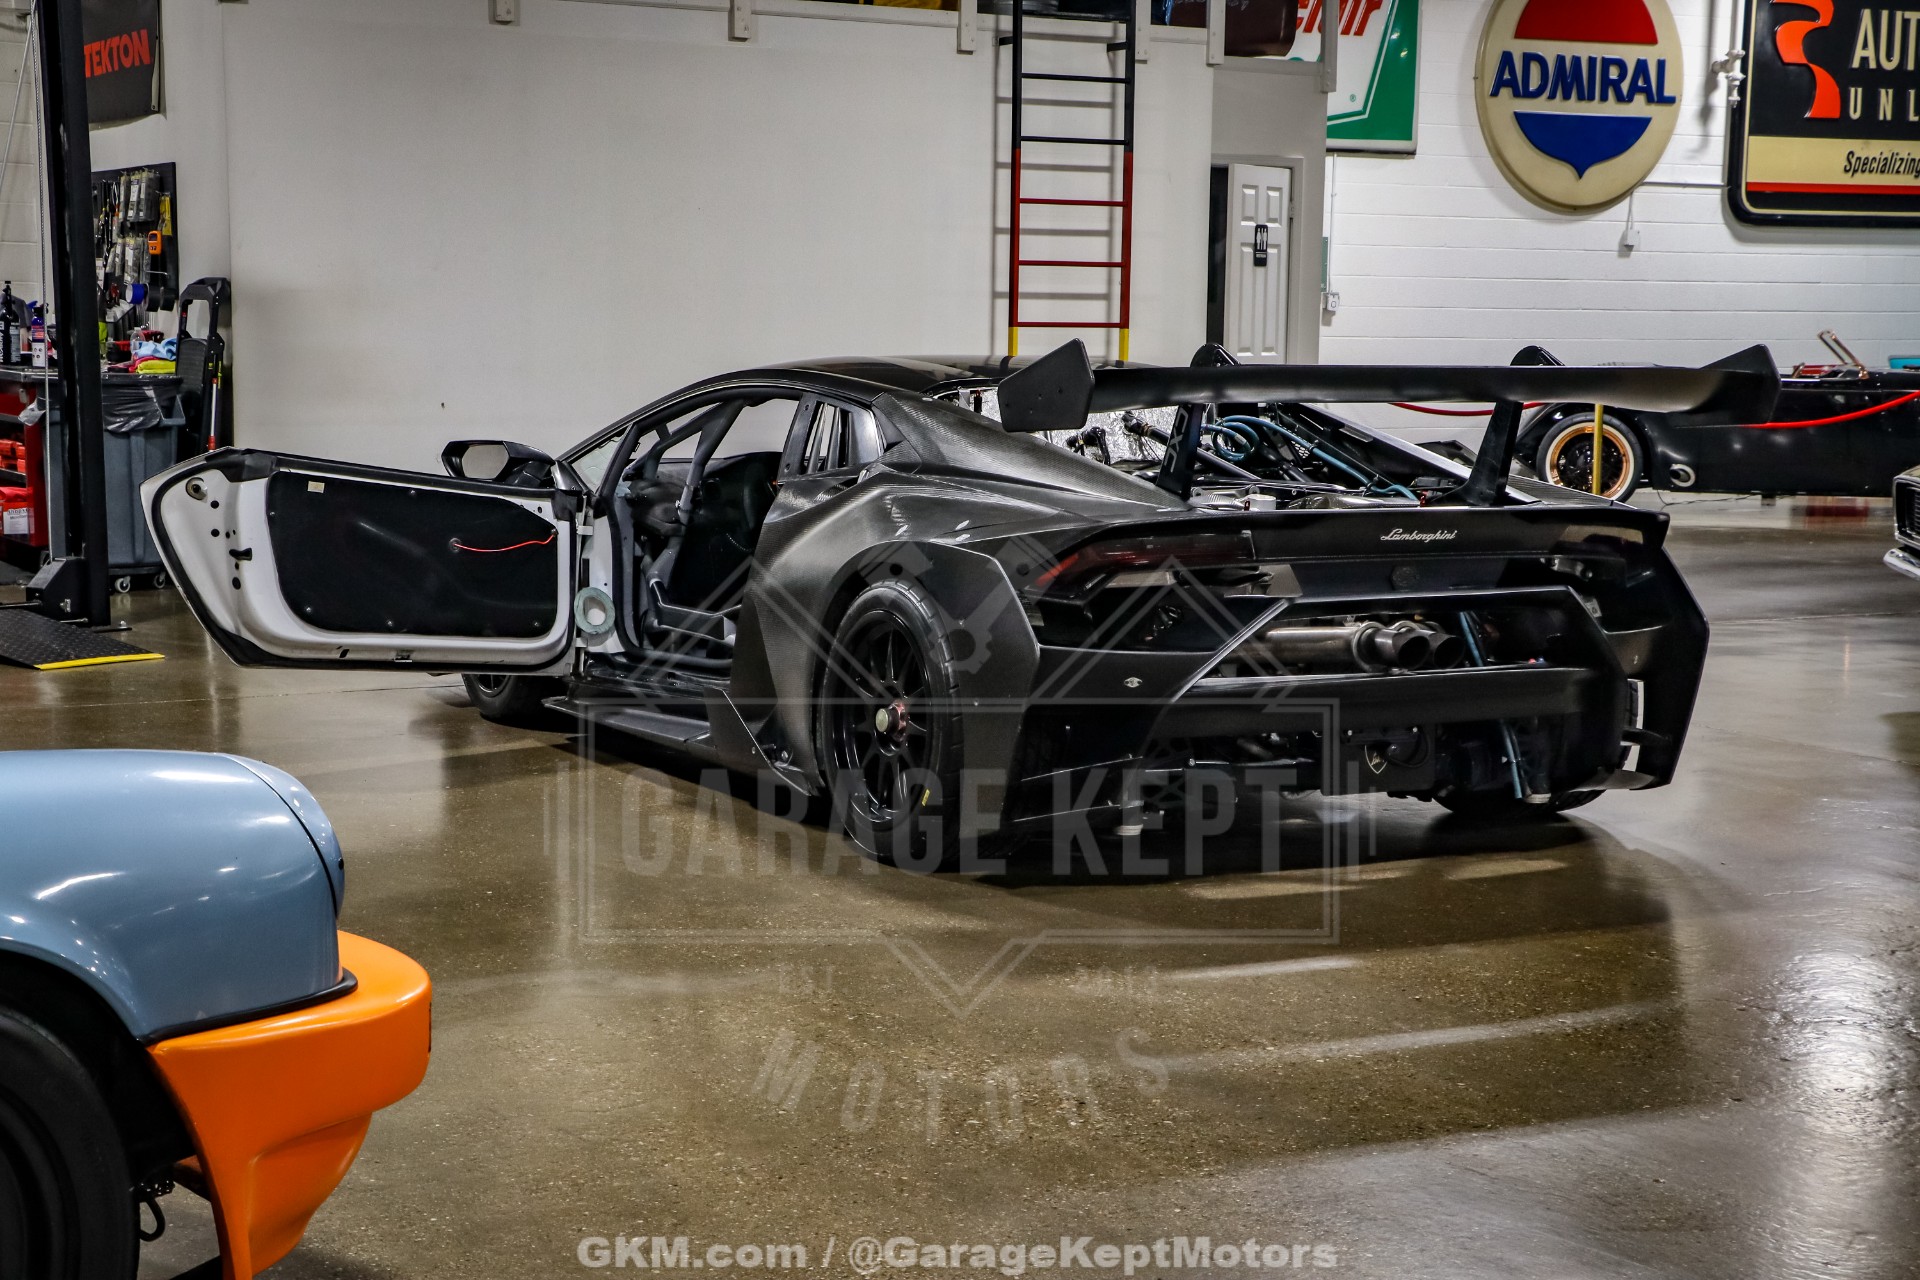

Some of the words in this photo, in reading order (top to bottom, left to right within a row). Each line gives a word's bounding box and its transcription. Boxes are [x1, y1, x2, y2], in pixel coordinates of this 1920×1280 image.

[83, 28, 151, 78] TEKTON
[1489, 50, 1676, 104] ADMIRAL
[1843, 150, 1920, 179] Specializing
[1380, 528, 1458, 543] Lamborghini
